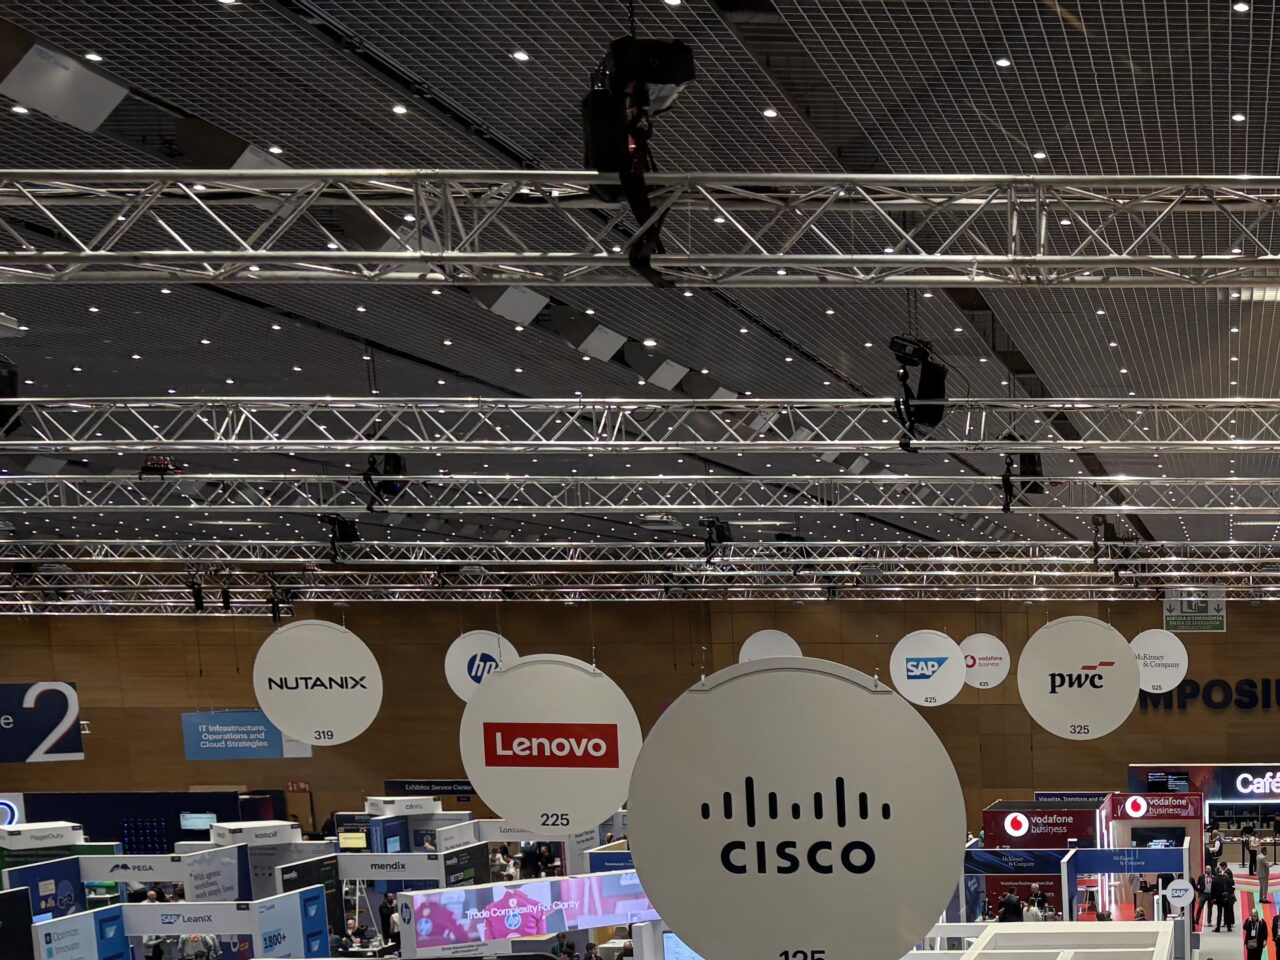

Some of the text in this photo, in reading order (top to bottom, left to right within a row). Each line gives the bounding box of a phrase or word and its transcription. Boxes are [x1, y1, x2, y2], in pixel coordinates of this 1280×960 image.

[906, 659, 939, 679] SAP
[1150, 661, 1180, 670] Company
[267, 676, 367, 691] NUTANIX
[1049, 672, 1104, 694] pwc
[22, 682, 85, 762] 2
[198, 724, 267, 733] IT Infrastructure,
[1069, 724, 1090, 735] 325
[201, 732, 265, 741] Operations and
[314, 730, 334, 740] 319
[199, 740, 269, 749] Cloud Strategies
[495, 731, 607, 758] Lenovo
[1149, 798, 1187, 806] vodafone
[1149, 806, 1182, 816] business
[540, 812, 570, 828] 225
[1030, 814, 1074, 824] vodafone
[1031, 824, 1068, 835] business
[30, 832, 64, 842] PagerDuty
[720, 840, 877, 875] CISCO
[131, 864, 154, 872] PEGA
[370, 861, 407, 871] mendix
[1171, 888, 1187, 897] SAP
[465, 899, 579, 921] Trade Complexity For Clarity
[161, 914, 213, 925] SAP LeanIX
[263, 933, 287, 949] 1800+
